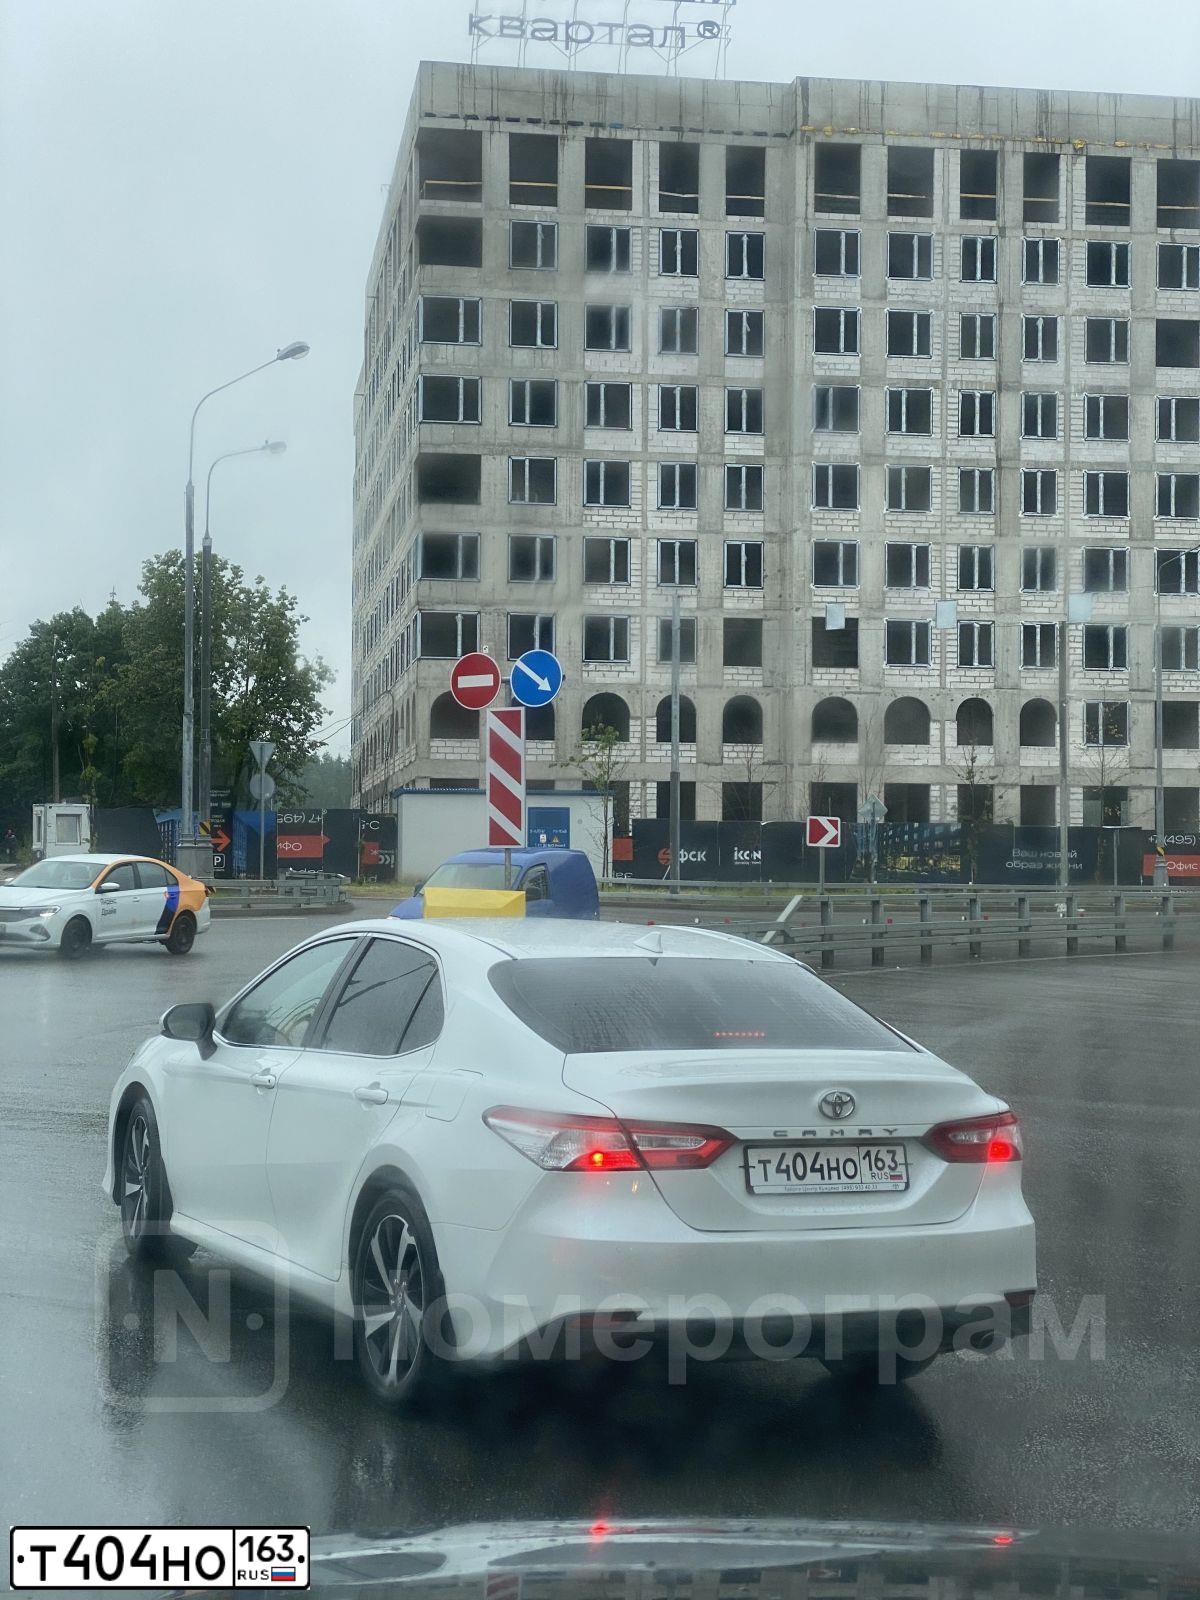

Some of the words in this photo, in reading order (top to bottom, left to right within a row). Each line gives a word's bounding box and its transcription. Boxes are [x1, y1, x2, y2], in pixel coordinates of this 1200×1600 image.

[1164, 834, 1196, 846] (495)
[1166, 860, 1199, 871] Офис
[773, 1128, 898, 1137] CAMRY
[757, 1151, 859, 1182] Т404НО
[862, 1149, 899, 1172] 163
[871, 1171, 889, 1181] RUS
